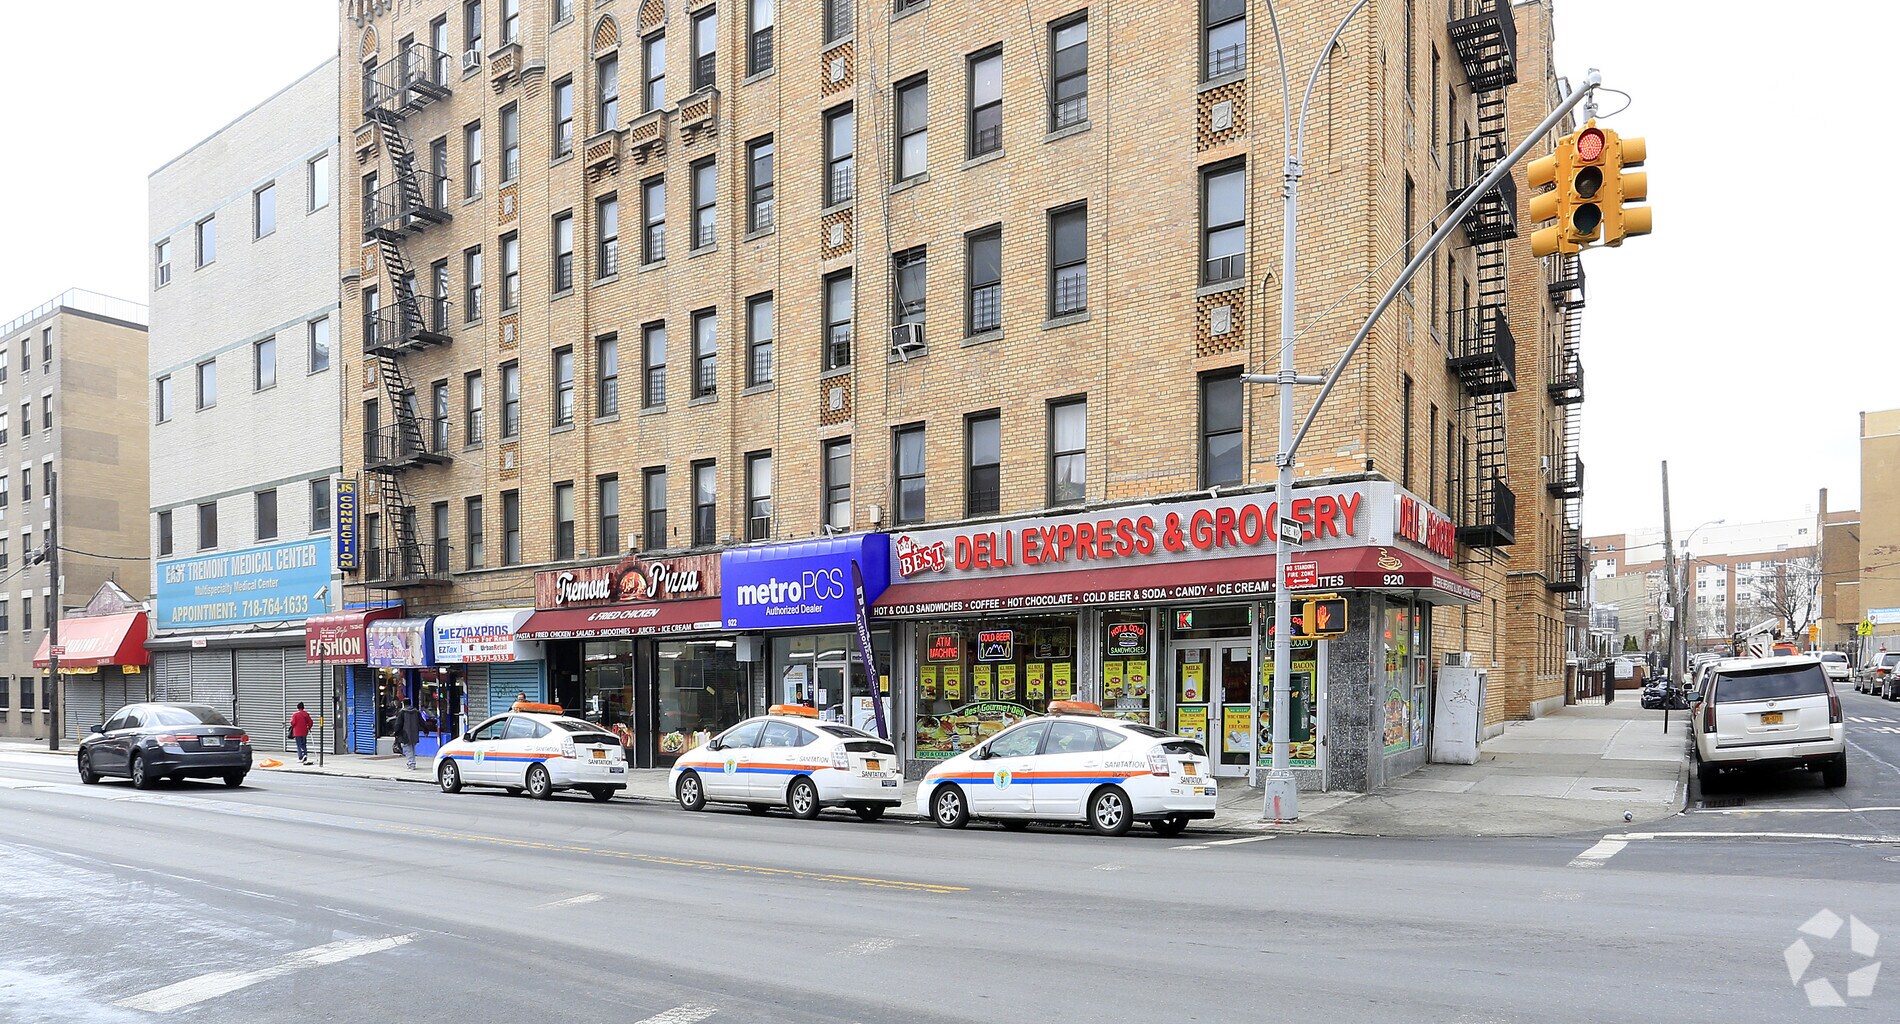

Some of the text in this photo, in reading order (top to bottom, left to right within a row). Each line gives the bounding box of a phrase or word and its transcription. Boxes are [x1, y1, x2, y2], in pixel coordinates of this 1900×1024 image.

[338, 484, 354, 493] JS
[1400, 494, 1418, 542] DELI
[340, 496, 353, 566] CONNECTION
[954, 492, 1361, 570] DELI EXPRESS & GROCERY
[166, 544, 316, 584] EAST TREMONT MEDICAL CENTER
[900, 543, 945, 576] BEST
[234, 580, 257, 592] Medical
[258, 578, 278, 590] Center
[556, 562, 698, 604] Tremont Pizza
[738, 568, 844, 606] metroPCS
[1384, 574, 1404, 586] 920
[874, 607, 888, 616] HOT
[896, 605, 915, 614] COLD
[916, 602, 963, 614] SANDWICHES
[970, 598, 1000, 610] COFFEE
[1008, 597, 1024, 608] HOT
[1025, 594, 1073, 606] CHOCOLATE
[1083, 592, 1107, 602] COLD
[1108, 590, 1132, 602] BEER
[1133, 590, 1140, 600] &
[1141, 588, 1167, 599] SODA
[1176, 585, 1208, 598] CANDY
[1216, 584, 1230, 594] ICE
[1230, 580, 1270, 594] CREAM
[172, 594, 309, 623] APPOINTMENT: 718-764-1633
[587, 608, 660, 622] & FRIED CHICKEN
[766, 604, 822, 616] Authorized Dealer
[728, 618, 737, 626] 922
[550, 630, 572, 638] CHICKEN
[600, 628, 630, 636] SMOOTHIES
[638, 626, 656, 634] JUICES
[672, 624, 692, 632] CREAM
[980, 632, 1010, 642] COLD BEER
[1110, 624, 1144, 637] HOT & COLD
[310, 637, 360, 657] FASHION
[936, 636, 951, 648] ATM
[930, 647, 958, 658] MACHINE
[1110, 646, 1144, 654] SANDWICHES
[964, 704, 1025, 717] Best Gourmet Deli
[1180, 776, 1202, 784] SANITATION
